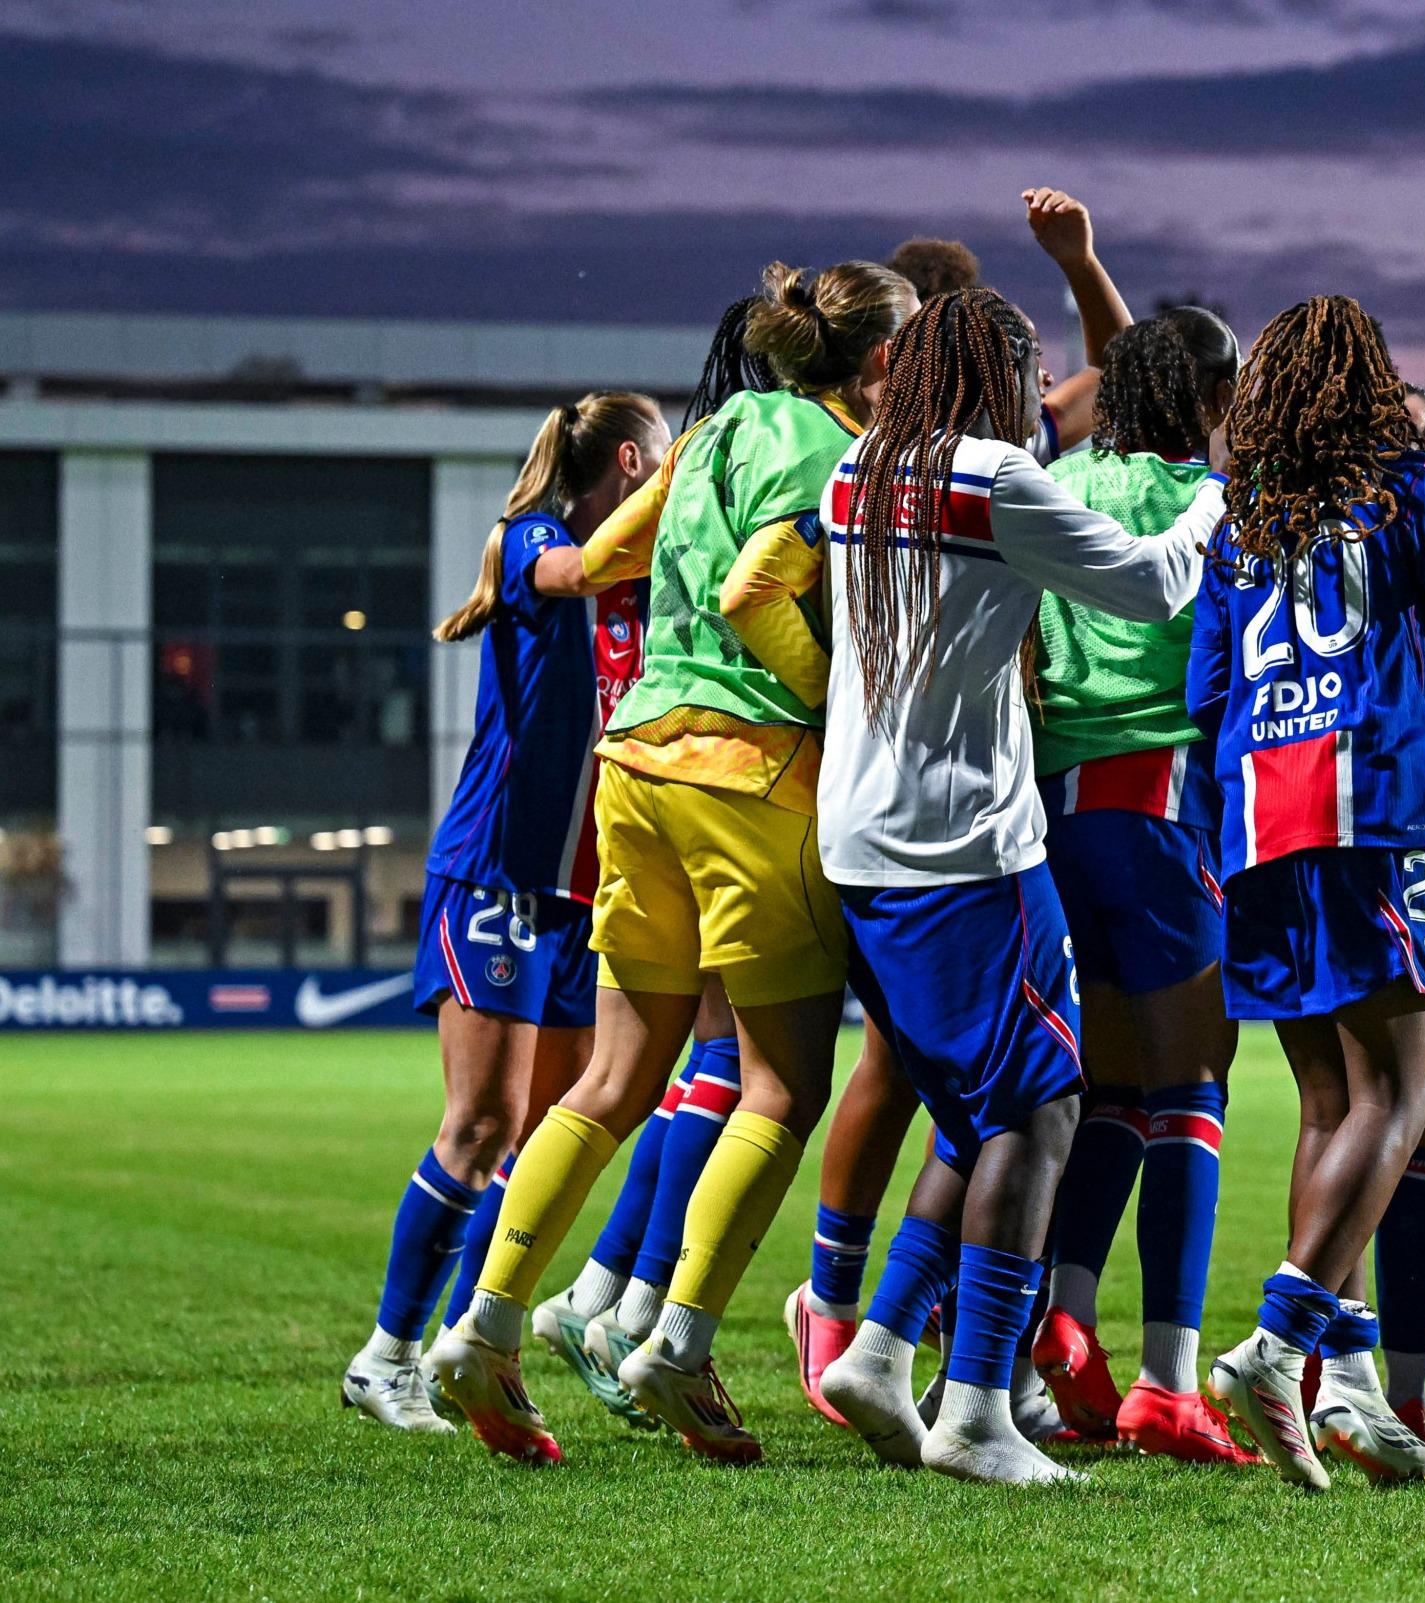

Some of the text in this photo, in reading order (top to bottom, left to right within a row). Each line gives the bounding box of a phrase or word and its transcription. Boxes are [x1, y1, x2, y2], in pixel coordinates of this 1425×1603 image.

[1235, 518, 1371, 682] 20
[1252, 708, 1339, 742] UNITED
[467, 887, 538, 952] 28
[504, 1227, 536, 1249] PARIS
